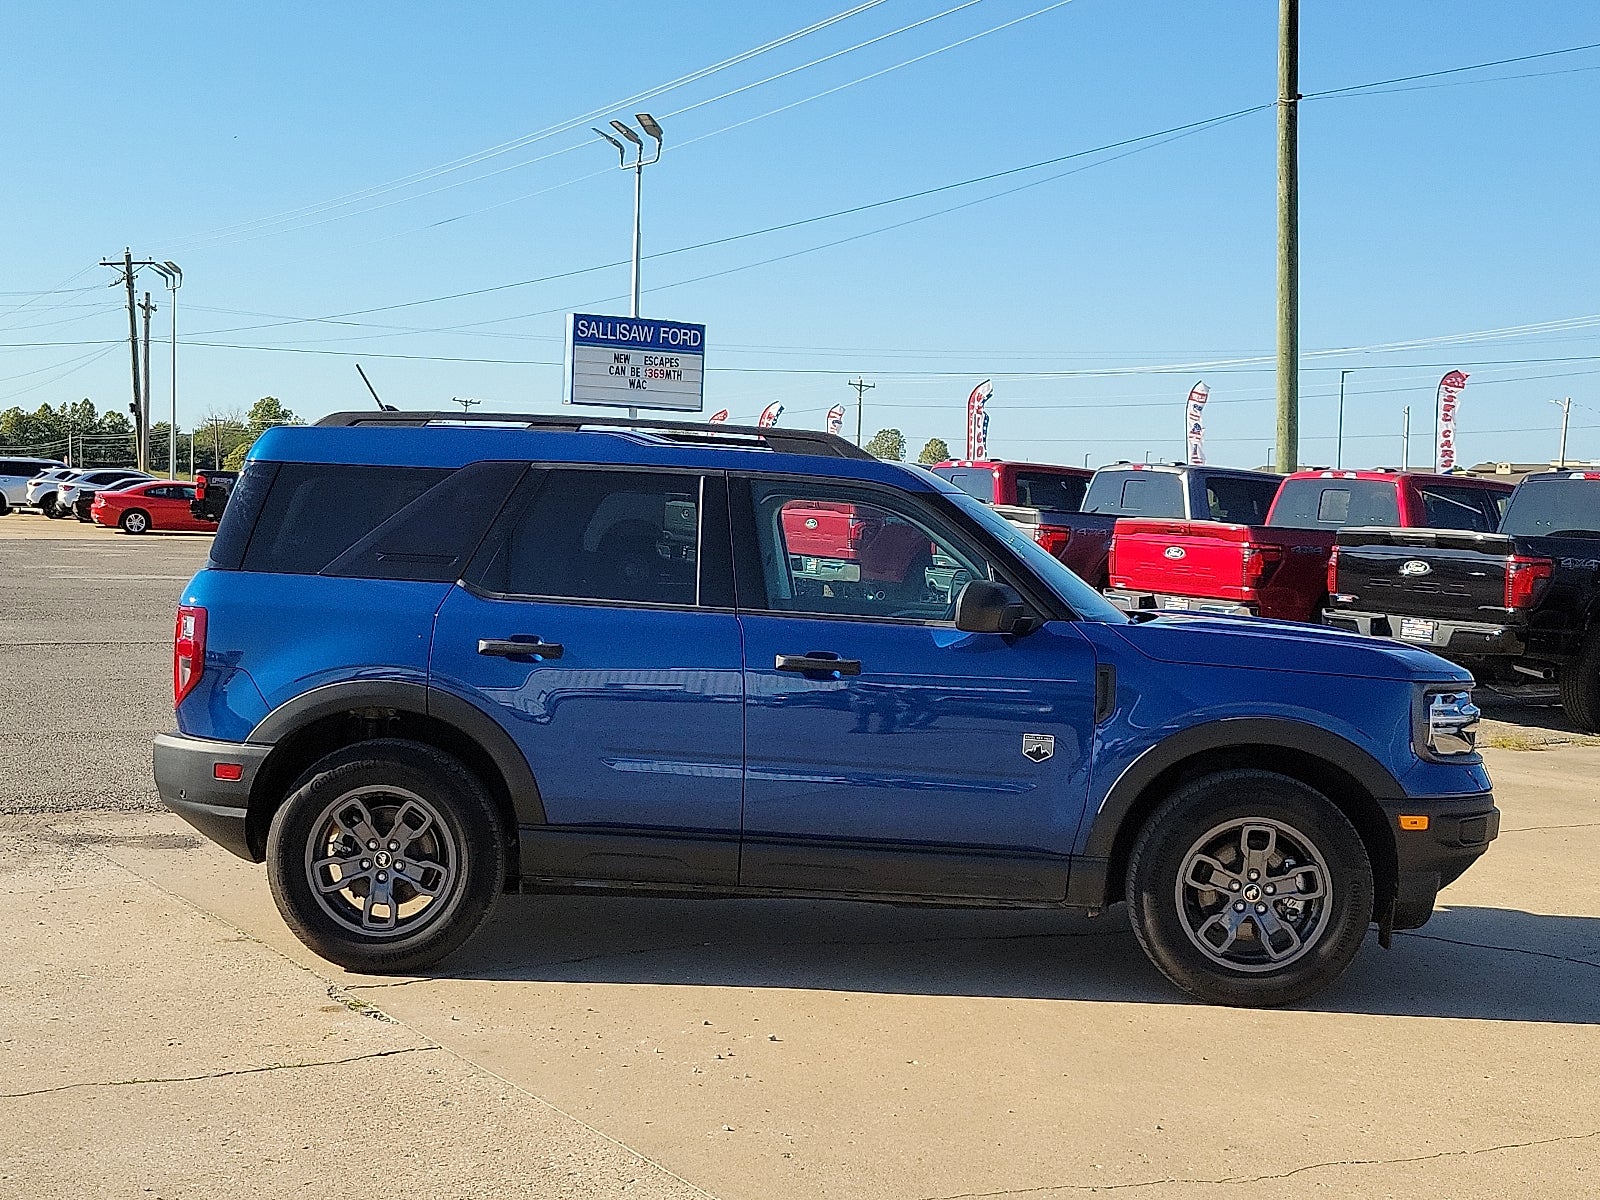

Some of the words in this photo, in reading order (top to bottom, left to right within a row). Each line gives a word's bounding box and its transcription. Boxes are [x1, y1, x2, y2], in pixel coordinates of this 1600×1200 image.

[577, 320, 654, 343] SALLISAW
[659, 327, 701, 346] FORD
[613, 353, 631, 364] NEW
[644, 355, 680, 368] ESCAPES
[608, 366, 626, 377] CAN
[630, 367, 641, 378] BE
[628, 379, 648, 390] WAC
[1440, 429, 1455, 468] CARS
